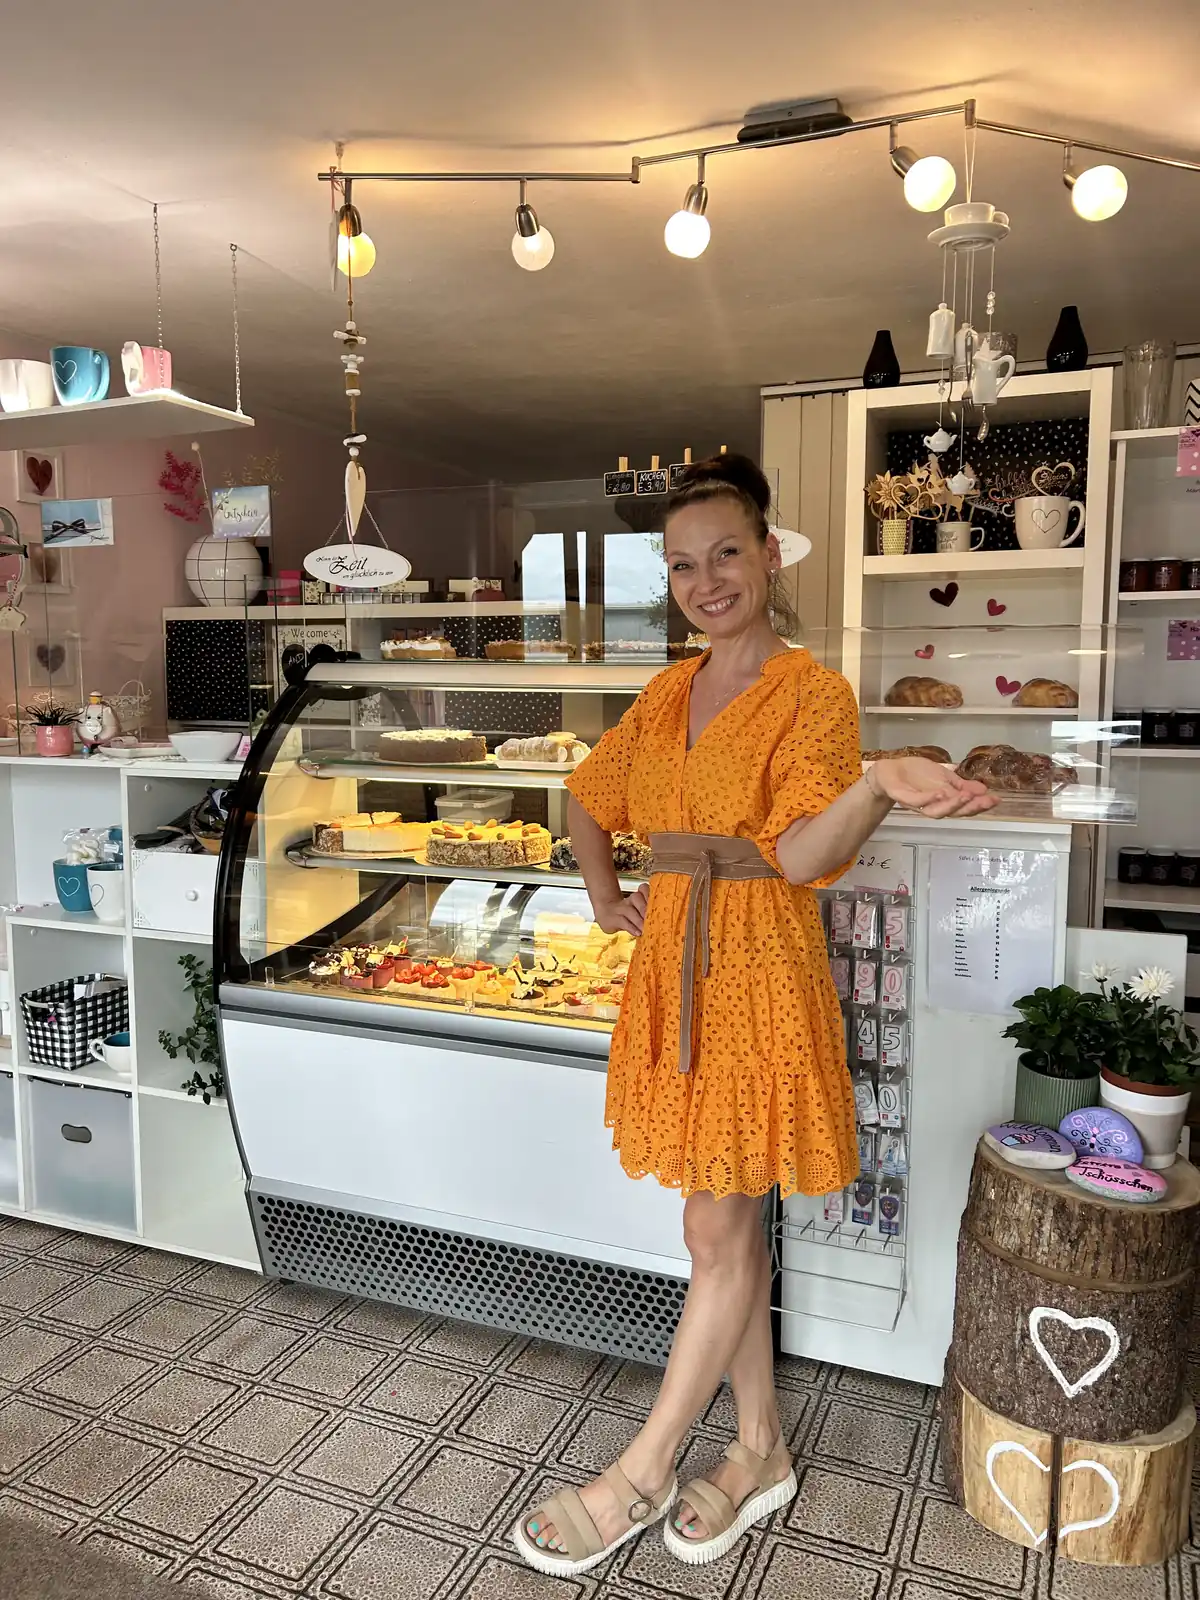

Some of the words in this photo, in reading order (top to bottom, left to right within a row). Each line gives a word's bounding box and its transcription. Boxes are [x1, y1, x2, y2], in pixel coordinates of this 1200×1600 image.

[291, 627, 328, 638] Wecome
[858, 1019, 875, 1045] 4
[883, 1025, 901, 1051] 5
